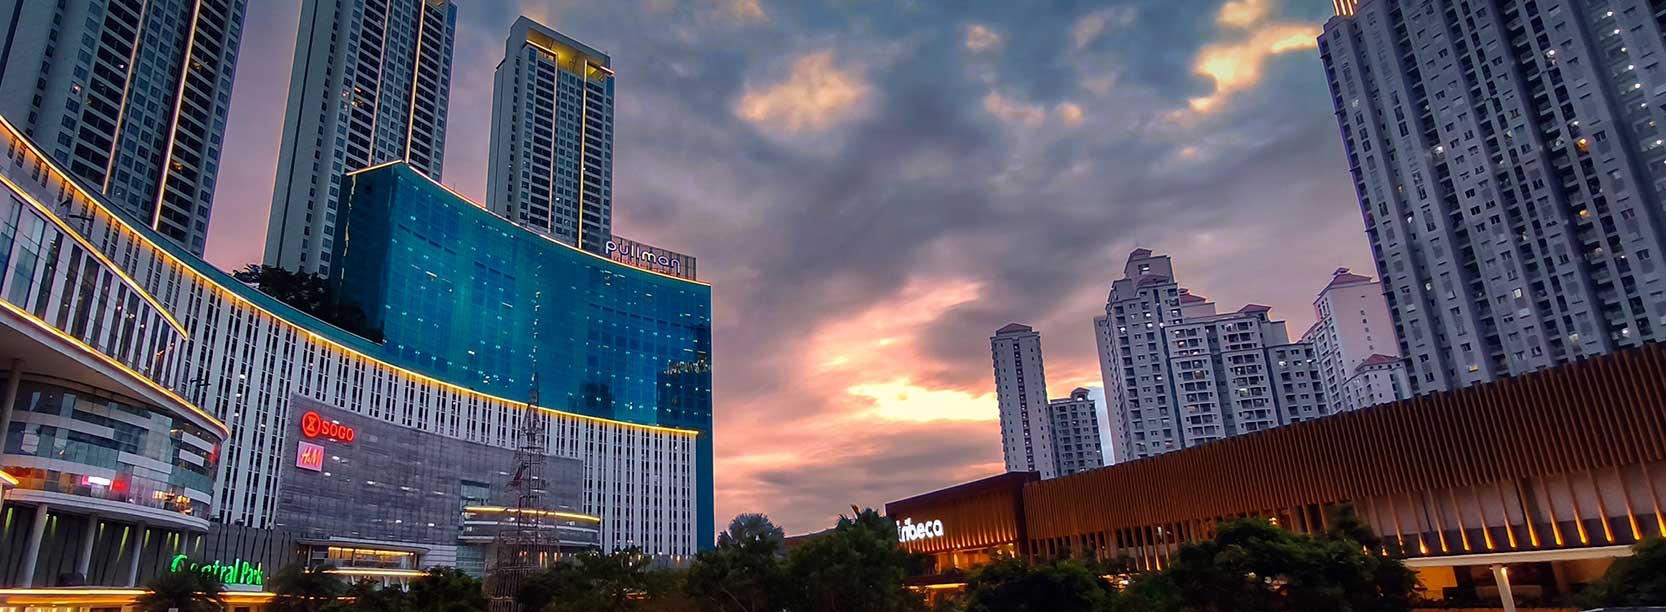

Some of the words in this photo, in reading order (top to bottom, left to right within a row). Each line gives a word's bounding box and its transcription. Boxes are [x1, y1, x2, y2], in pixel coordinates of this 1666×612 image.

[605, 240, 681, 273] pullman
[321, 420, 354, 441] SOGO
[240, 561, 263, 584] Park
